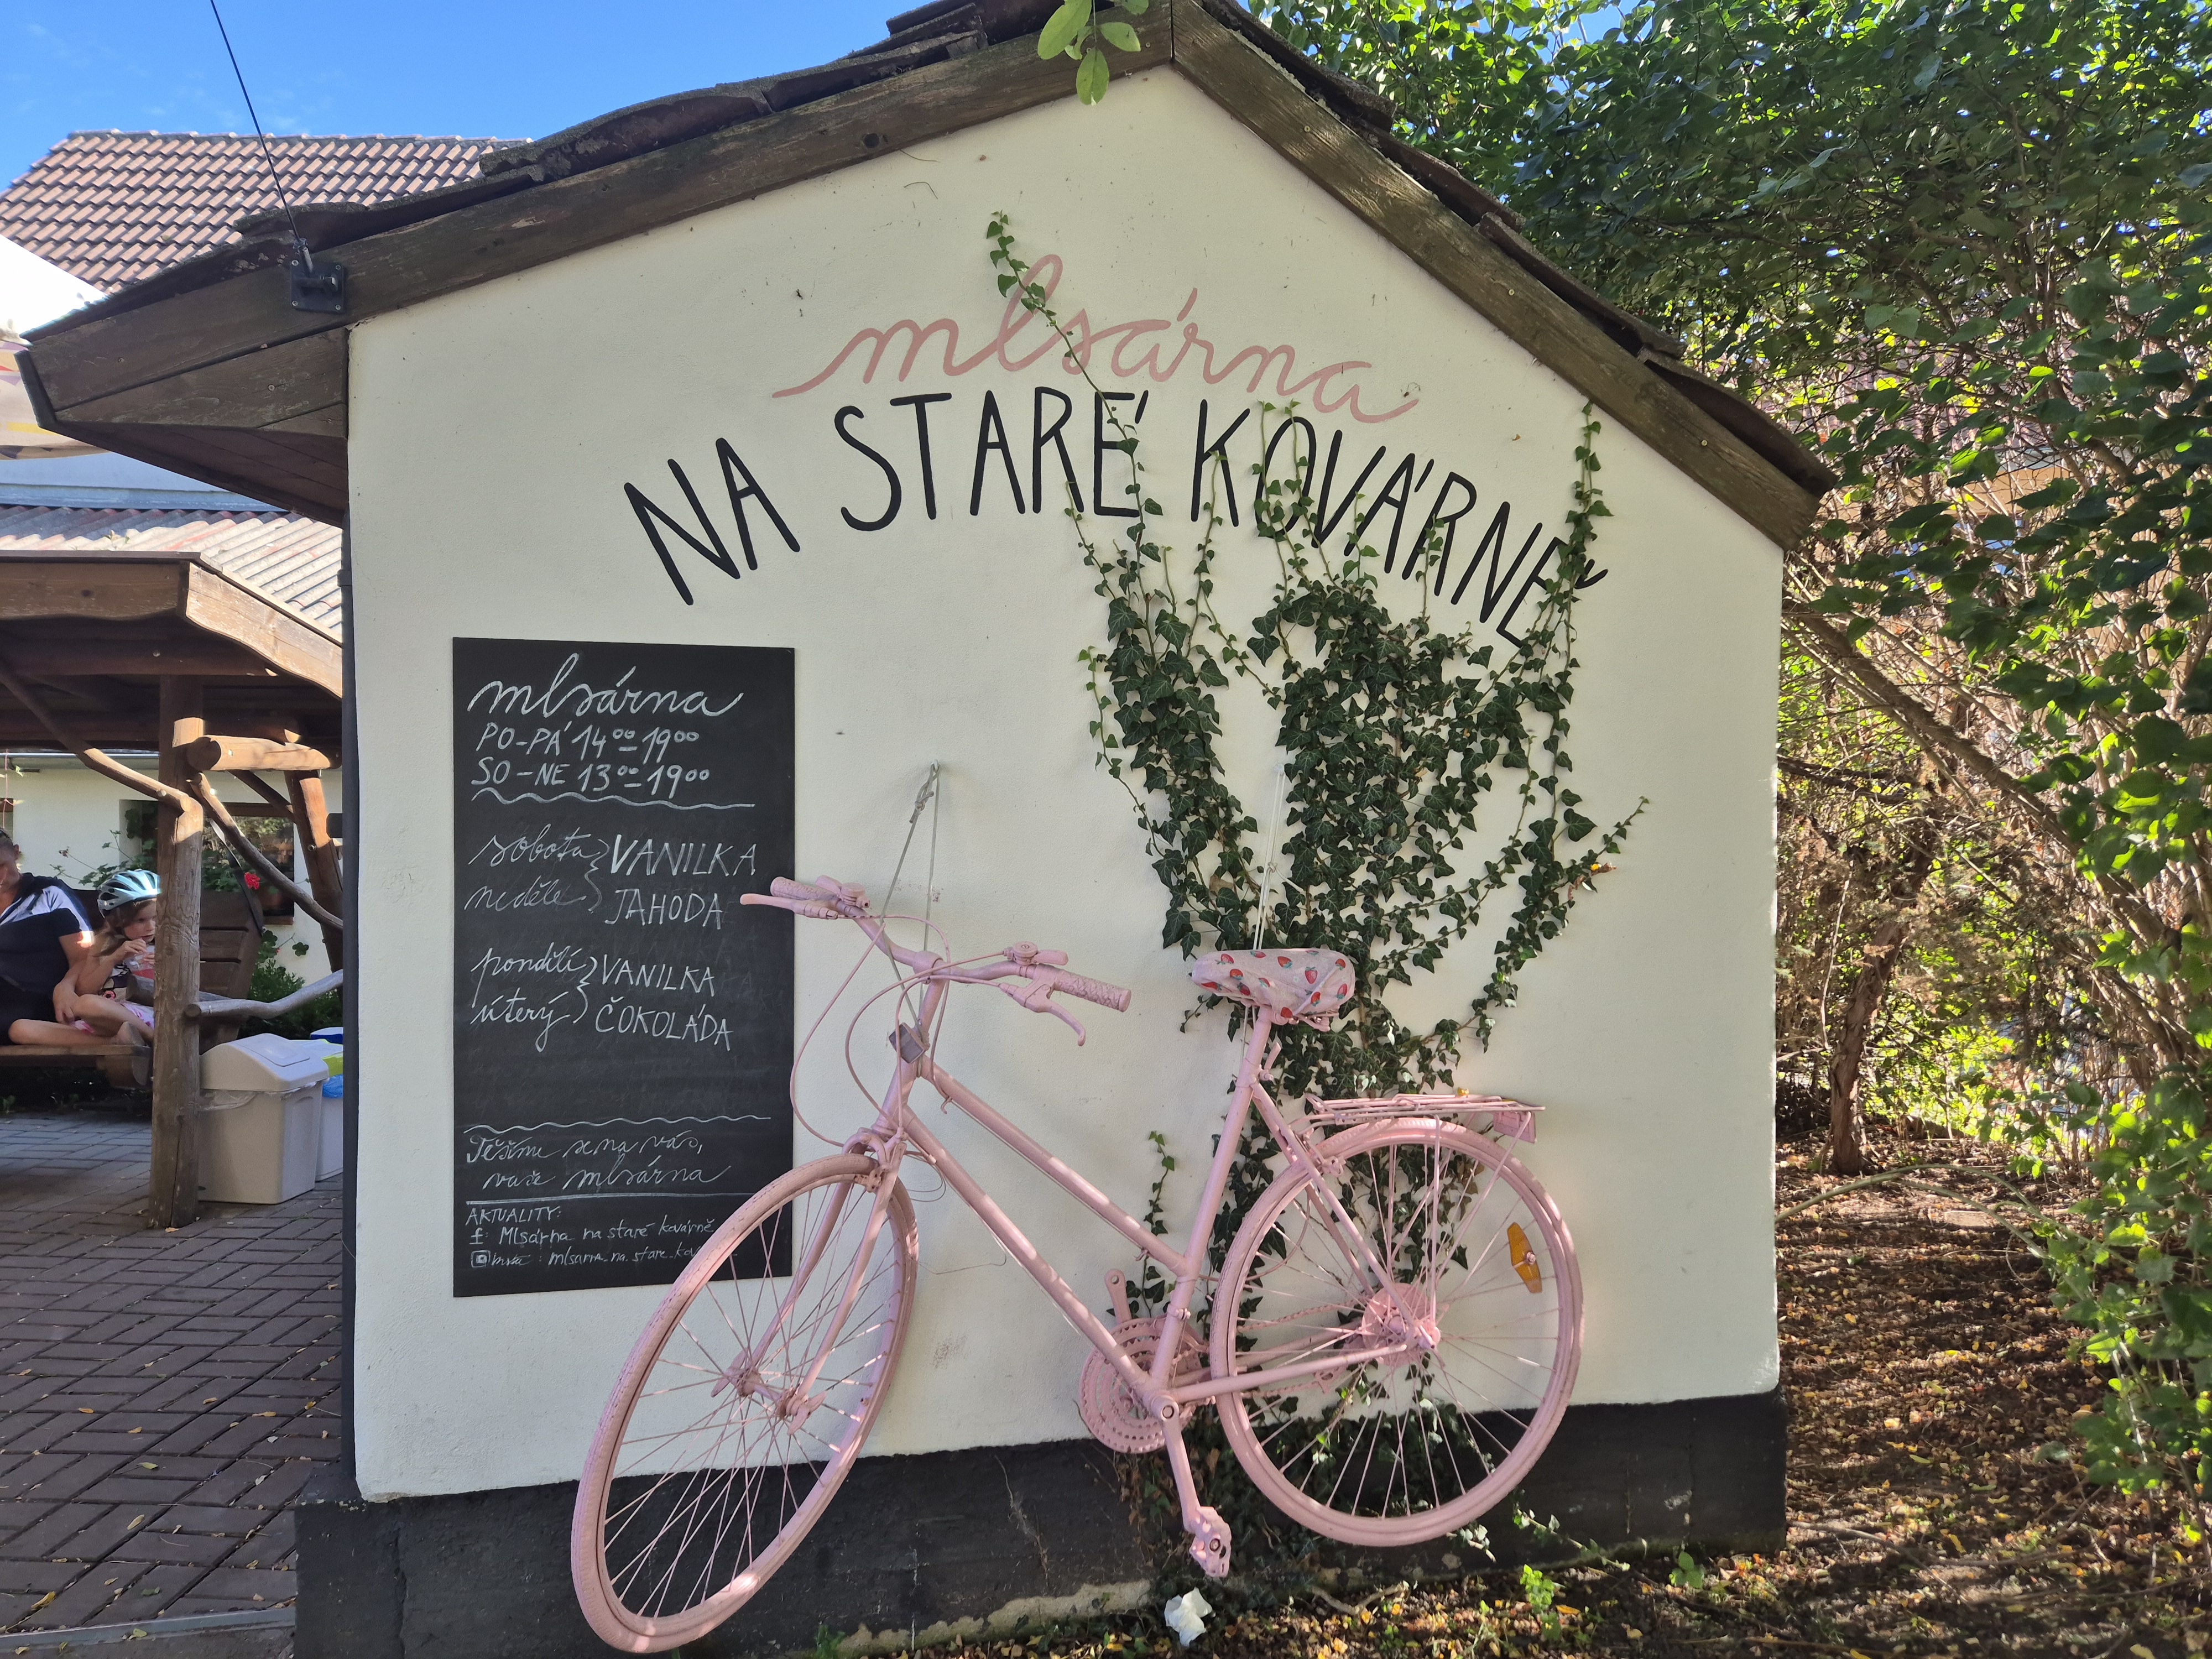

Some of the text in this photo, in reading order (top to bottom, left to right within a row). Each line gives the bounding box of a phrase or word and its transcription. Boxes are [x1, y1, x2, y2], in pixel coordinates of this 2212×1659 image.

[773, 253, 1420, 422] mlsárna
[624, 437, 801, 606] NA
[833, 386, 1150, 532] STARÉ
[467, 653, 744, 718] mlsárna
[468, 823, 757, 877] sobota VANILKA
[605, 888, 723, 930] JAHODA
[602, 954, 715, 997] VANILKA
[470, 987, 734, 1052] úterý ČOKOLÁDA
[482, 1152, 732, 1191] vaše mlsárna
[465, 1206, 562, 1225] AKTUALITY:
[499, 1226, 576, 1245] Mlsárna
[582, 1228, 602, 1240] na
[607, 1219, 656, 1240] staré
[658, 1214, 716, 1237] kovárně
